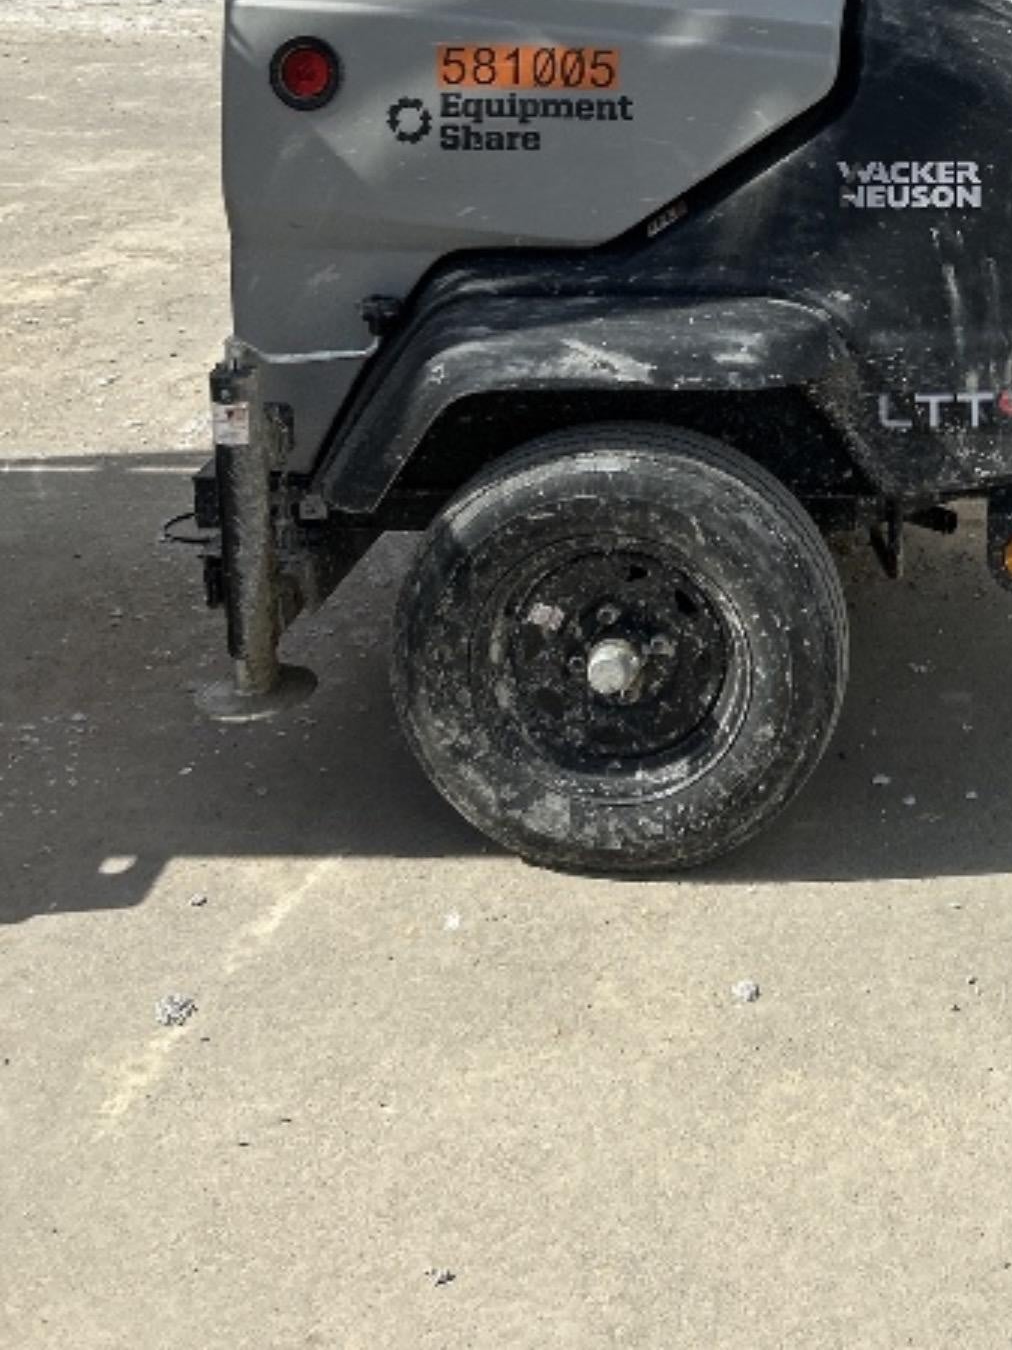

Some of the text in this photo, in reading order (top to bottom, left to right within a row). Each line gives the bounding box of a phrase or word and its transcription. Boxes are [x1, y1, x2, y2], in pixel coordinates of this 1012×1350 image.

[441, 46, 618, 89] 581005
[440, 93, 634, 124] Equipment
[440, 125, 541, 151] Share
[836, 161, 982, 185] WACKER
